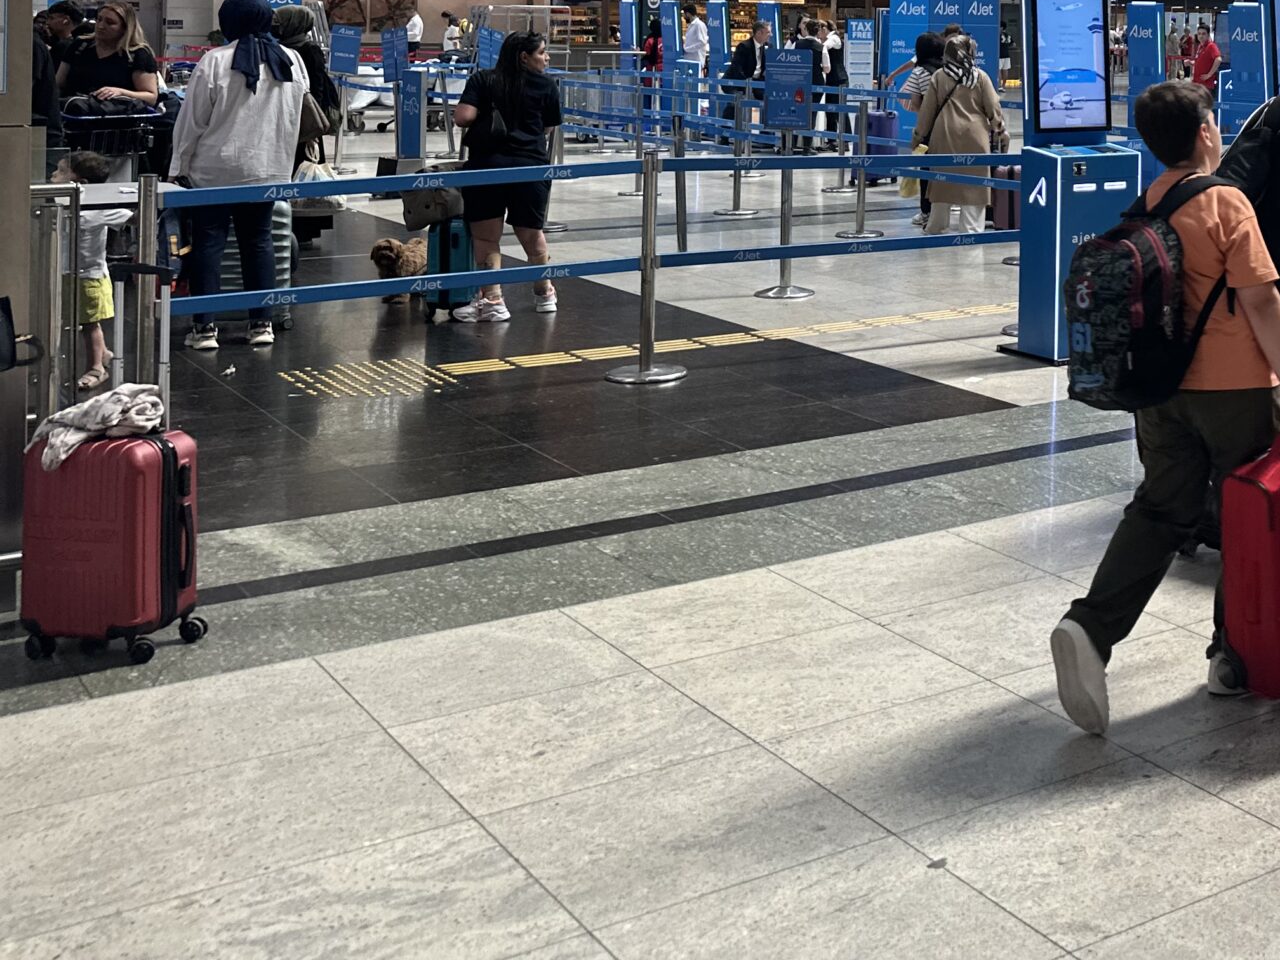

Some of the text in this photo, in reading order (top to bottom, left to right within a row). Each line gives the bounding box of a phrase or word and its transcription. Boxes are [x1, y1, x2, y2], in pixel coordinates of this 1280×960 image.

[896, 1, 926, 16] AJet
[934, 1, 960, 16] AJet
[968, 1, 993, 16] AJet
[850, 22, 872, 31] TAX
[1129, 24, 1153, 38] AJet
[1232, 27, 1258, 42] AJet
[776, 52, 801, 63] AJet
[544, 167, 572, 178] AJet
[412, 176, 444, 189] AJet
[264, 186, 299, 199] AJet
[952, 235, 975, 246] AJet
[848, 242, 872, 252] AJet
[734, 250, 761, 261] AJet
[541, 267, 570, 278] AJet
[410, 280, 442, 291] AJet
[262, 292, 297, 305] AJet
